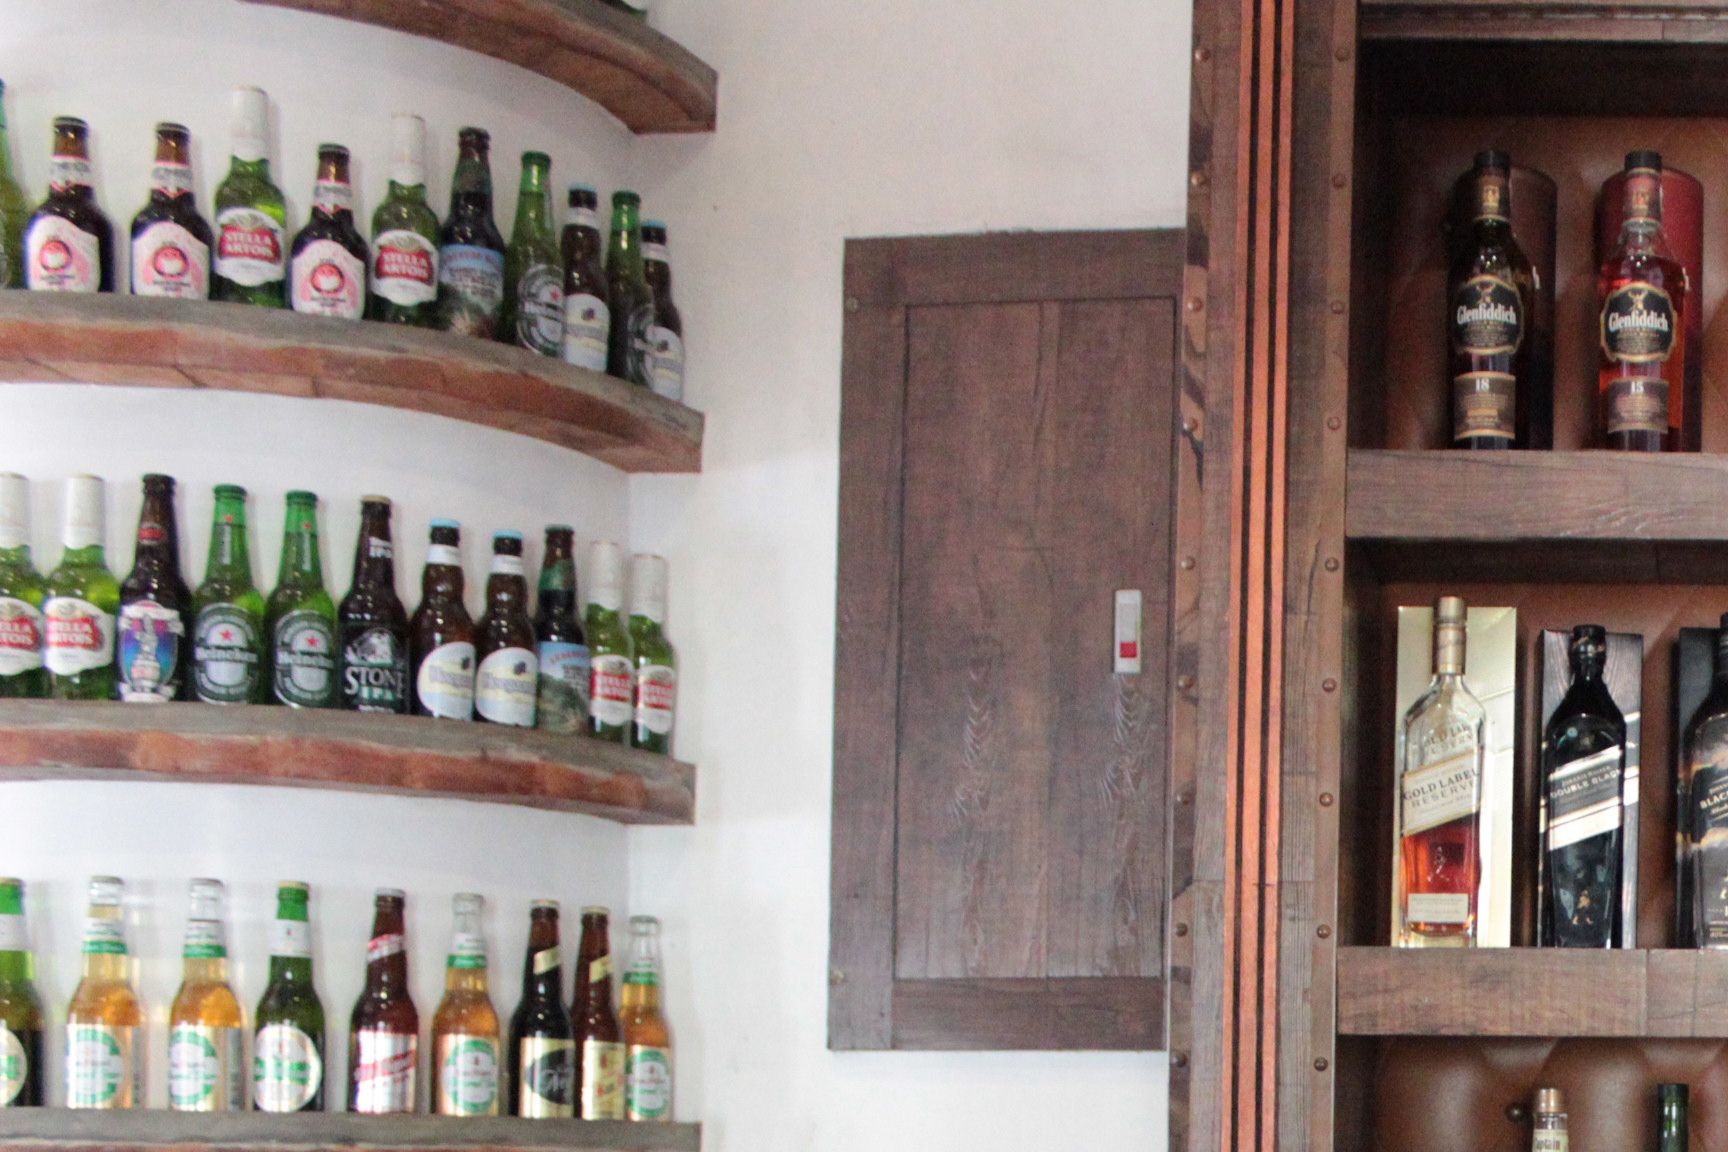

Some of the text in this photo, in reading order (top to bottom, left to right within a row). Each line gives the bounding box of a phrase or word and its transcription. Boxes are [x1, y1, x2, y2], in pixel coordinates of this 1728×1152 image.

[1457, 303, 1517, 325] Glenfiddich
[1608, 309, 1669, 332] Glenfiddich
[1475, 377, 1490, 392] 18
[1630, 380, 1645, 393] 15
